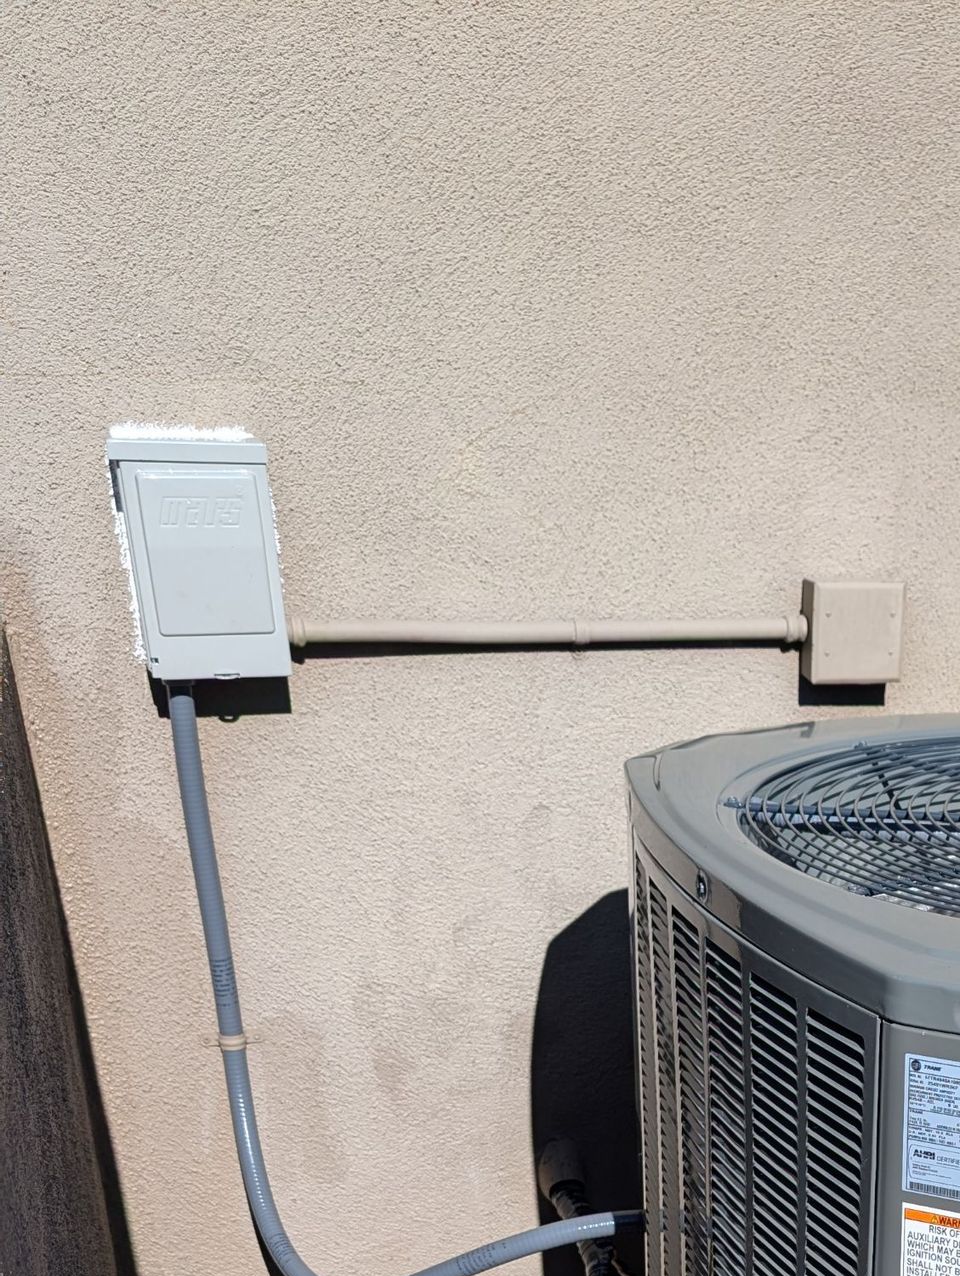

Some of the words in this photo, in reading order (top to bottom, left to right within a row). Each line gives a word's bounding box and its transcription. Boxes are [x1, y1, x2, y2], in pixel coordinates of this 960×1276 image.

[907, 1230, 950, 1246] AUXILIARY
[929, 1224, 947, 1235] RISK
[949, 1229, 959, 1238] OF
[907, 1239, 934, 1252] WHICH
[937, 1245, 953, 1256] MAY
[907, 1248, 942, 1262] IGNITION
[907, 1257, 933, 1270] SHALL
[935, 1263, 952, 1274] NOT
